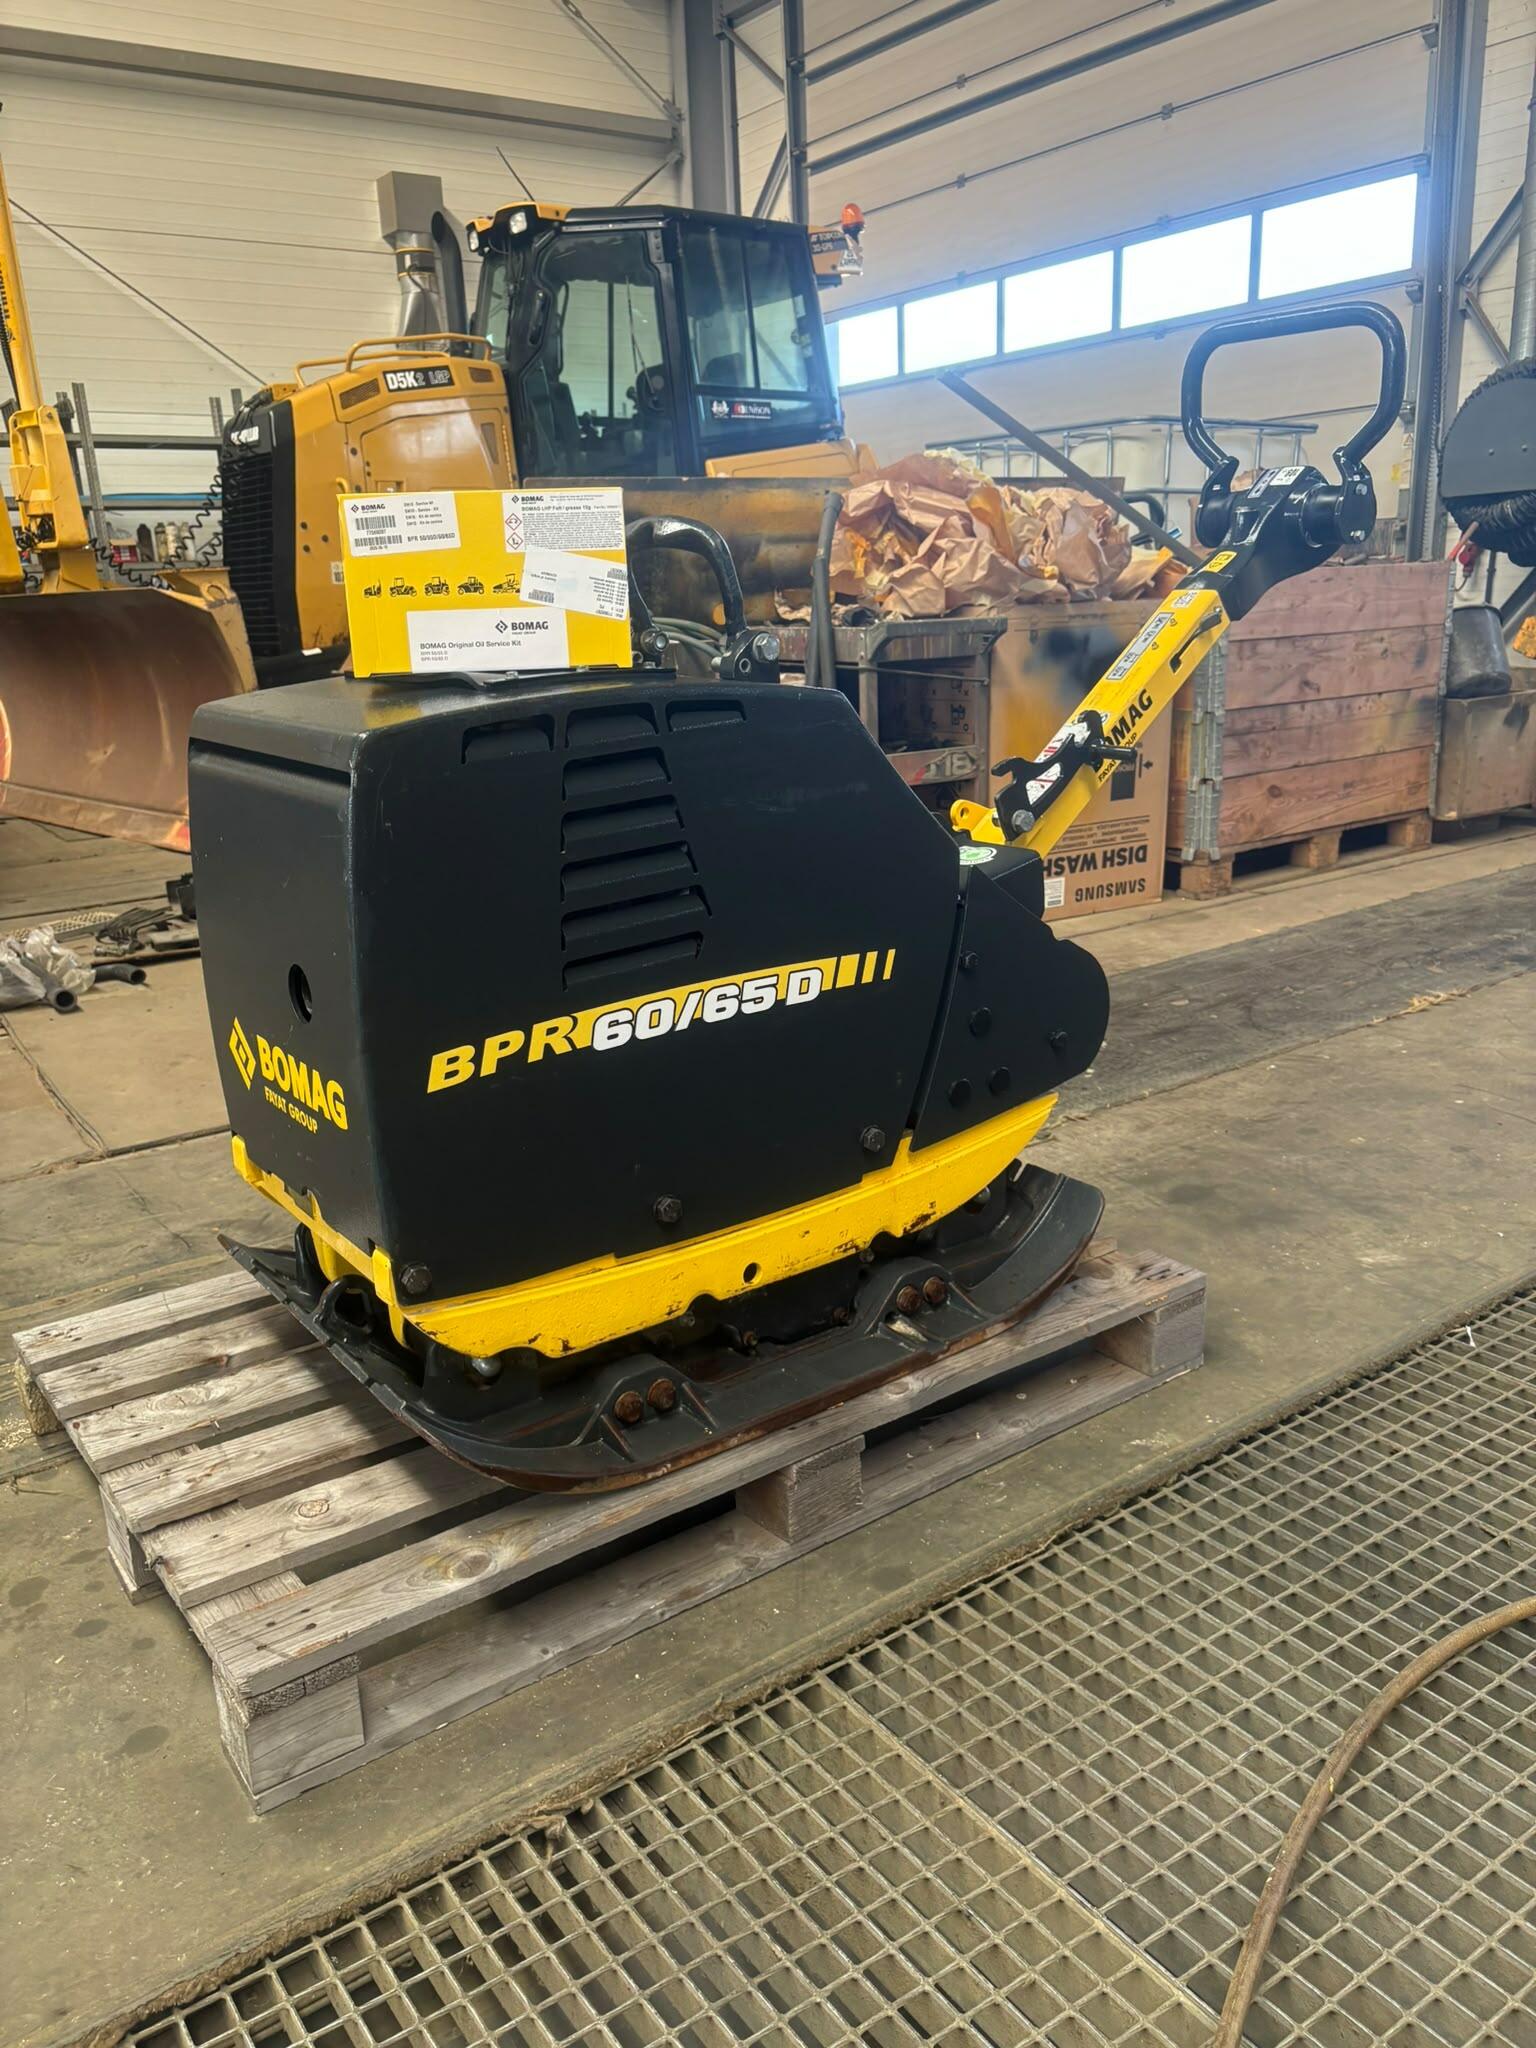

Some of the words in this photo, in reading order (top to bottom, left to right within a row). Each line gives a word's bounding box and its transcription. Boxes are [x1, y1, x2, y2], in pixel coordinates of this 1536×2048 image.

[361, 503, 386, 511] BOMAG
[511, 620, 549, 631] BOMAG
[448, 641, 474, 650] Original
[1102, 845, 1148, 868] DISH
[1075, 878, 1146, 902] SAMSUNG
[427, 1015, 583, 1094] BPR
[593, 975, 779, 1051] 60/65
[785, 967, 823, 1006] D
[256, 1034, 348, 1130] BOMAG
[264, 1086, 287, 1114] FAYAT
[288, 1102, 318, 1134] GROUP
